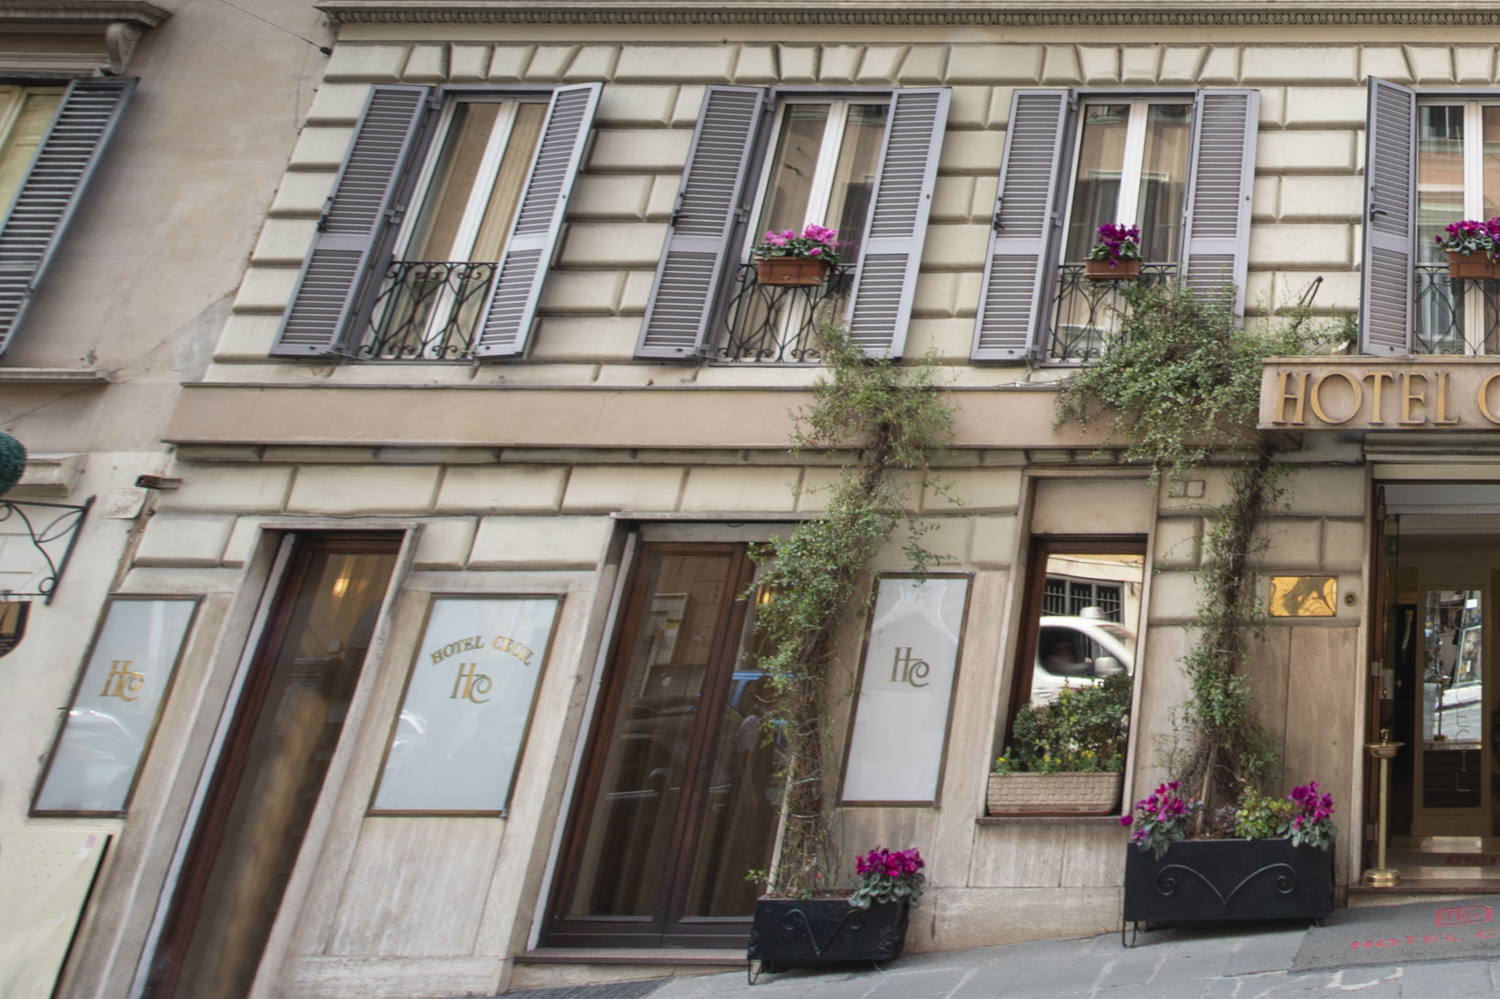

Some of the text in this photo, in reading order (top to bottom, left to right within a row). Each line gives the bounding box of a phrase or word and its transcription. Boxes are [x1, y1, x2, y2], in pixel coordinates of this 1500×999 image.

[1272, 370, 1461, 426] HOTEL
[429, 635, 534, 666] HOTEL CECIL
[1350, 933, 1463, 950] HOTEL
